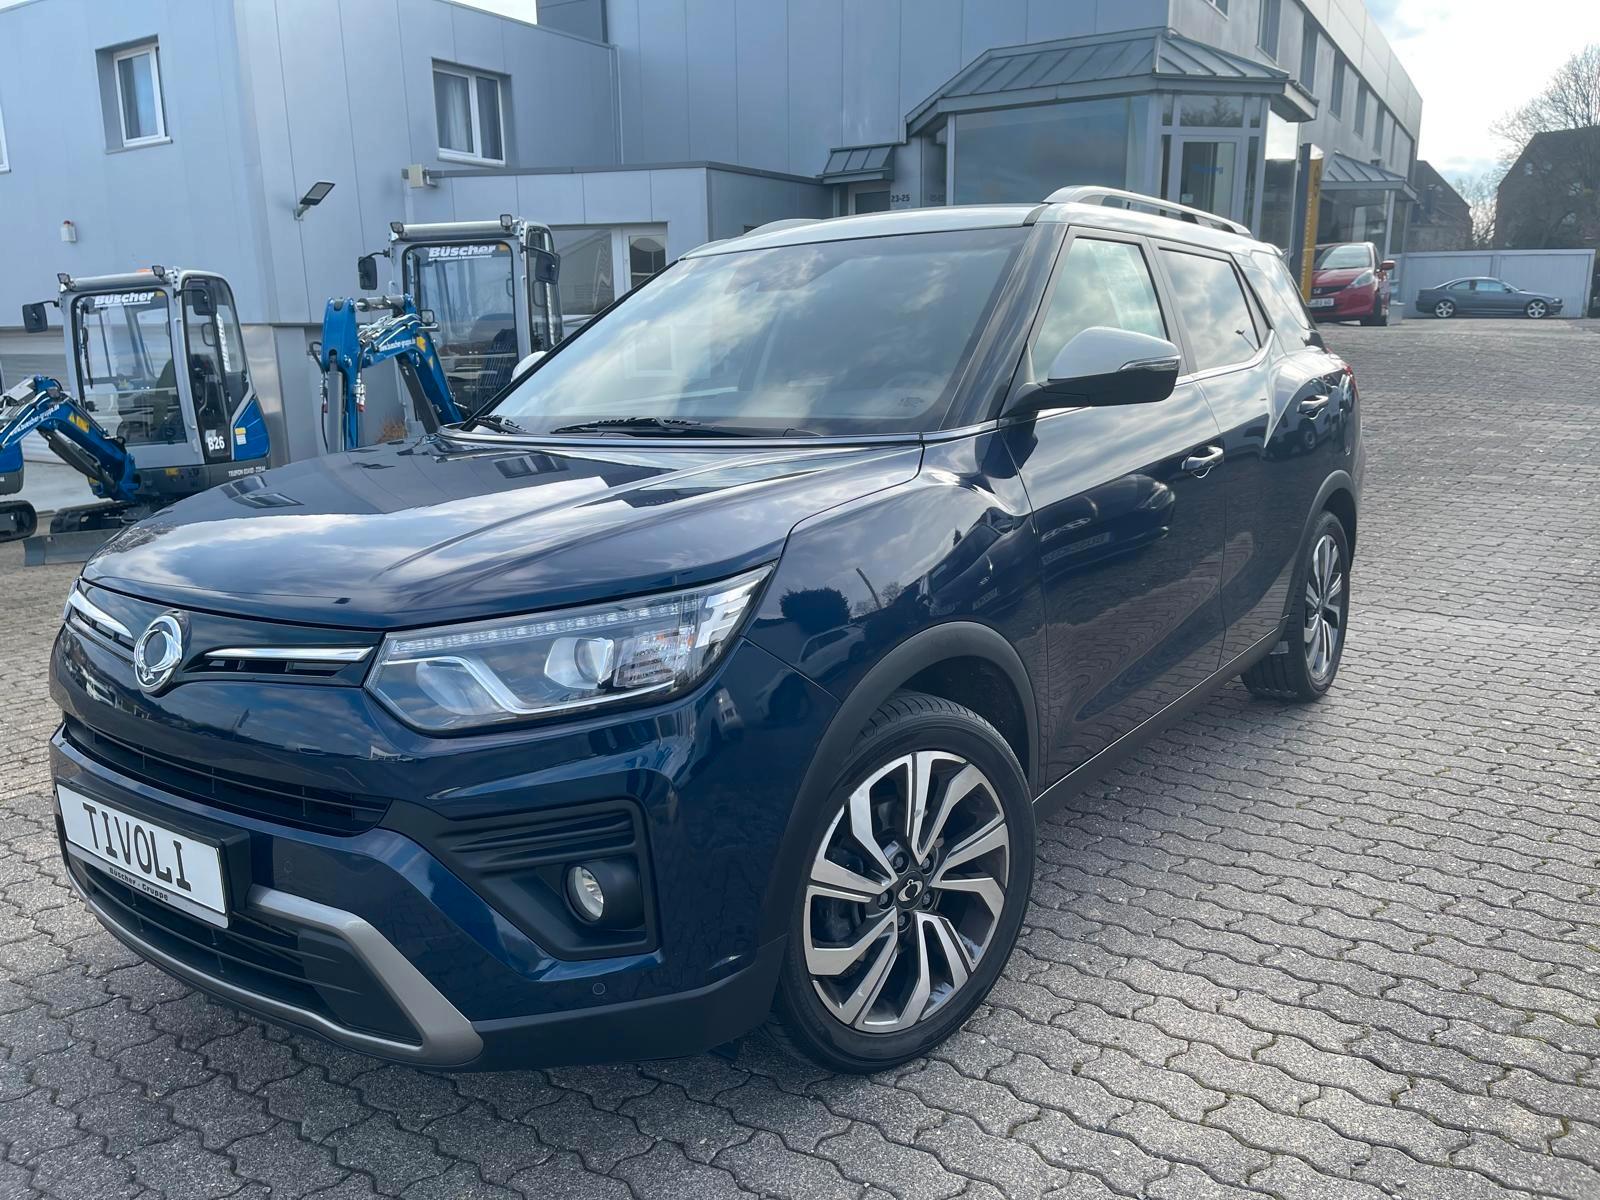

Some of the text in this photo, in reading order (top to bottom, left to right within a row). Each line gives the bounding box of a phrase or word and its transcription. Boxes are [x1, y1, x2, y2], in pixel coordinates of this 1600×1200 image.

[428, 245, 496, 257] Büscher
[207, 436, 225, 451] B26
[83, 802, 192, 892] TIVOLI
